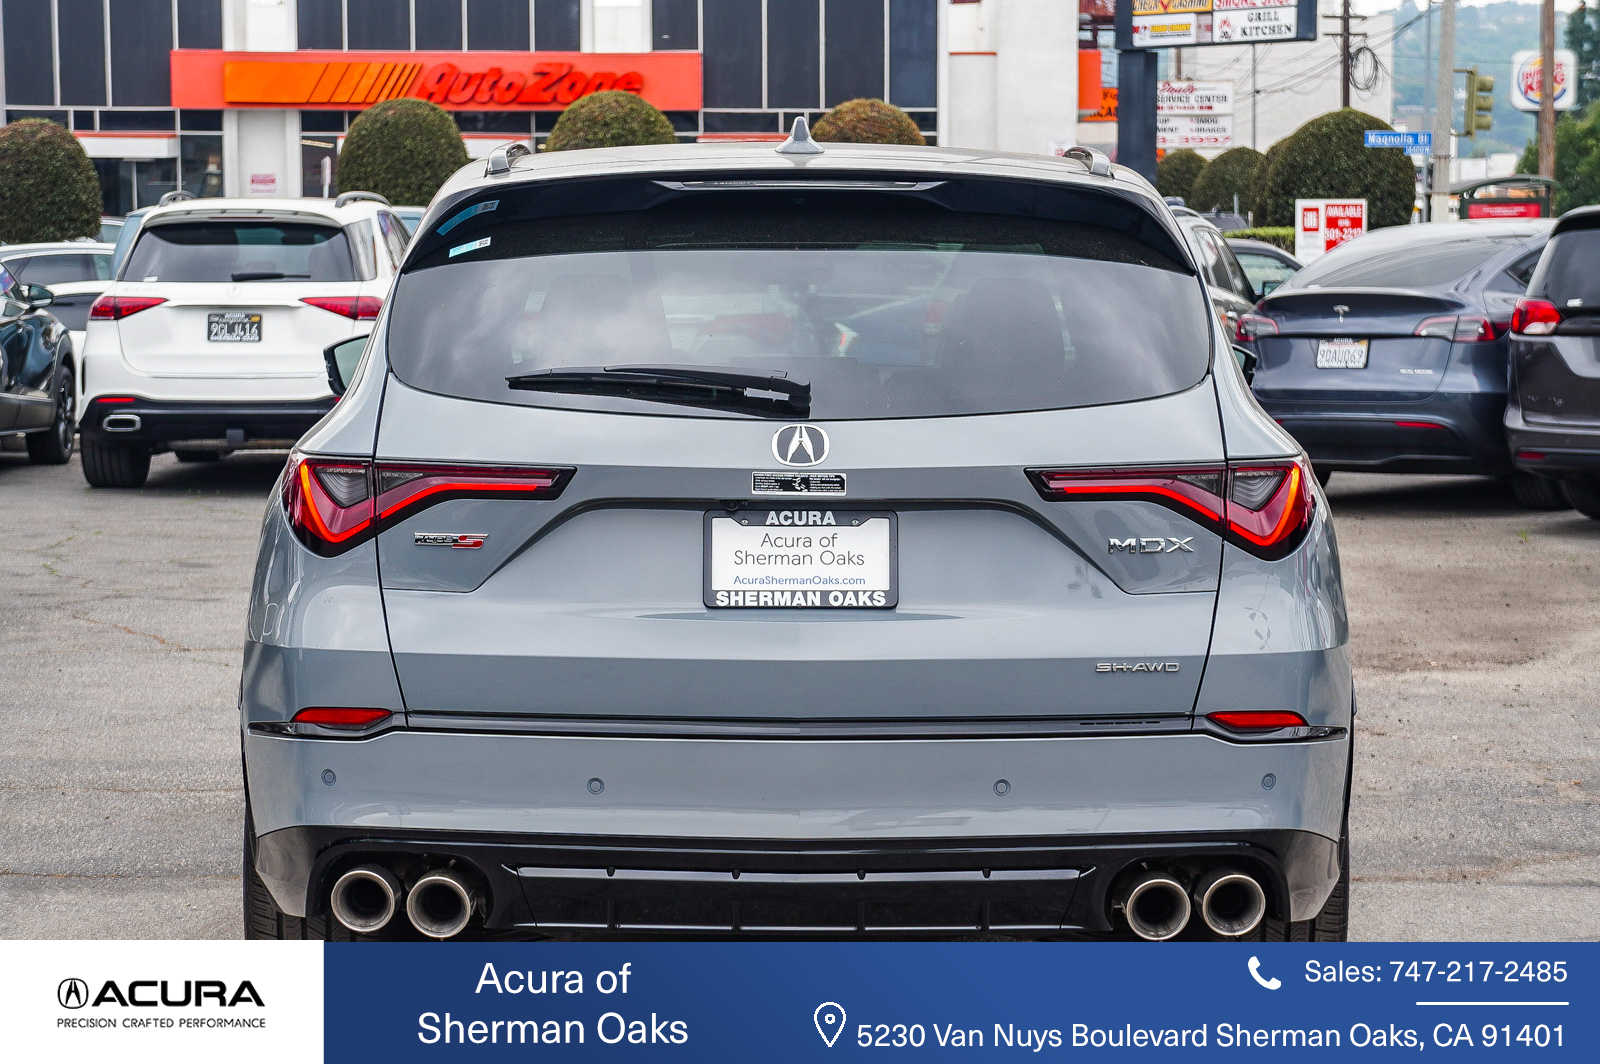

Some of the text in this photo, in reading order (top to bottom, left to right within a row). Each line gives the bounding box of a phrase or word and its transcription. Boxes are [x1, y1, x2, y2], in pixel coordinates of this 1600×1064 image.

[1247, 11, 1280, 22] GRILL
[1240, 23, 1293, 37] KITCHEN
[416, 62, 644, 105] AutoZone
[1368, 133, 1413, 145] Magnolia
[1326, 205, 1362, 217] AVAILABLE
[765, 511, 836, 526] ACURA
[760, 533, 838, 548] Acura of
[1108, 536, 1195, 553] MDX
[734, 550, 865, 566] Sherman Oaks
[733, 576, 866, 585] AcuraShermanOaks.com
[715, 591, 886, 607] SHERMAN OAKS
[1095, 662, 1181, 673] SH-AWD
